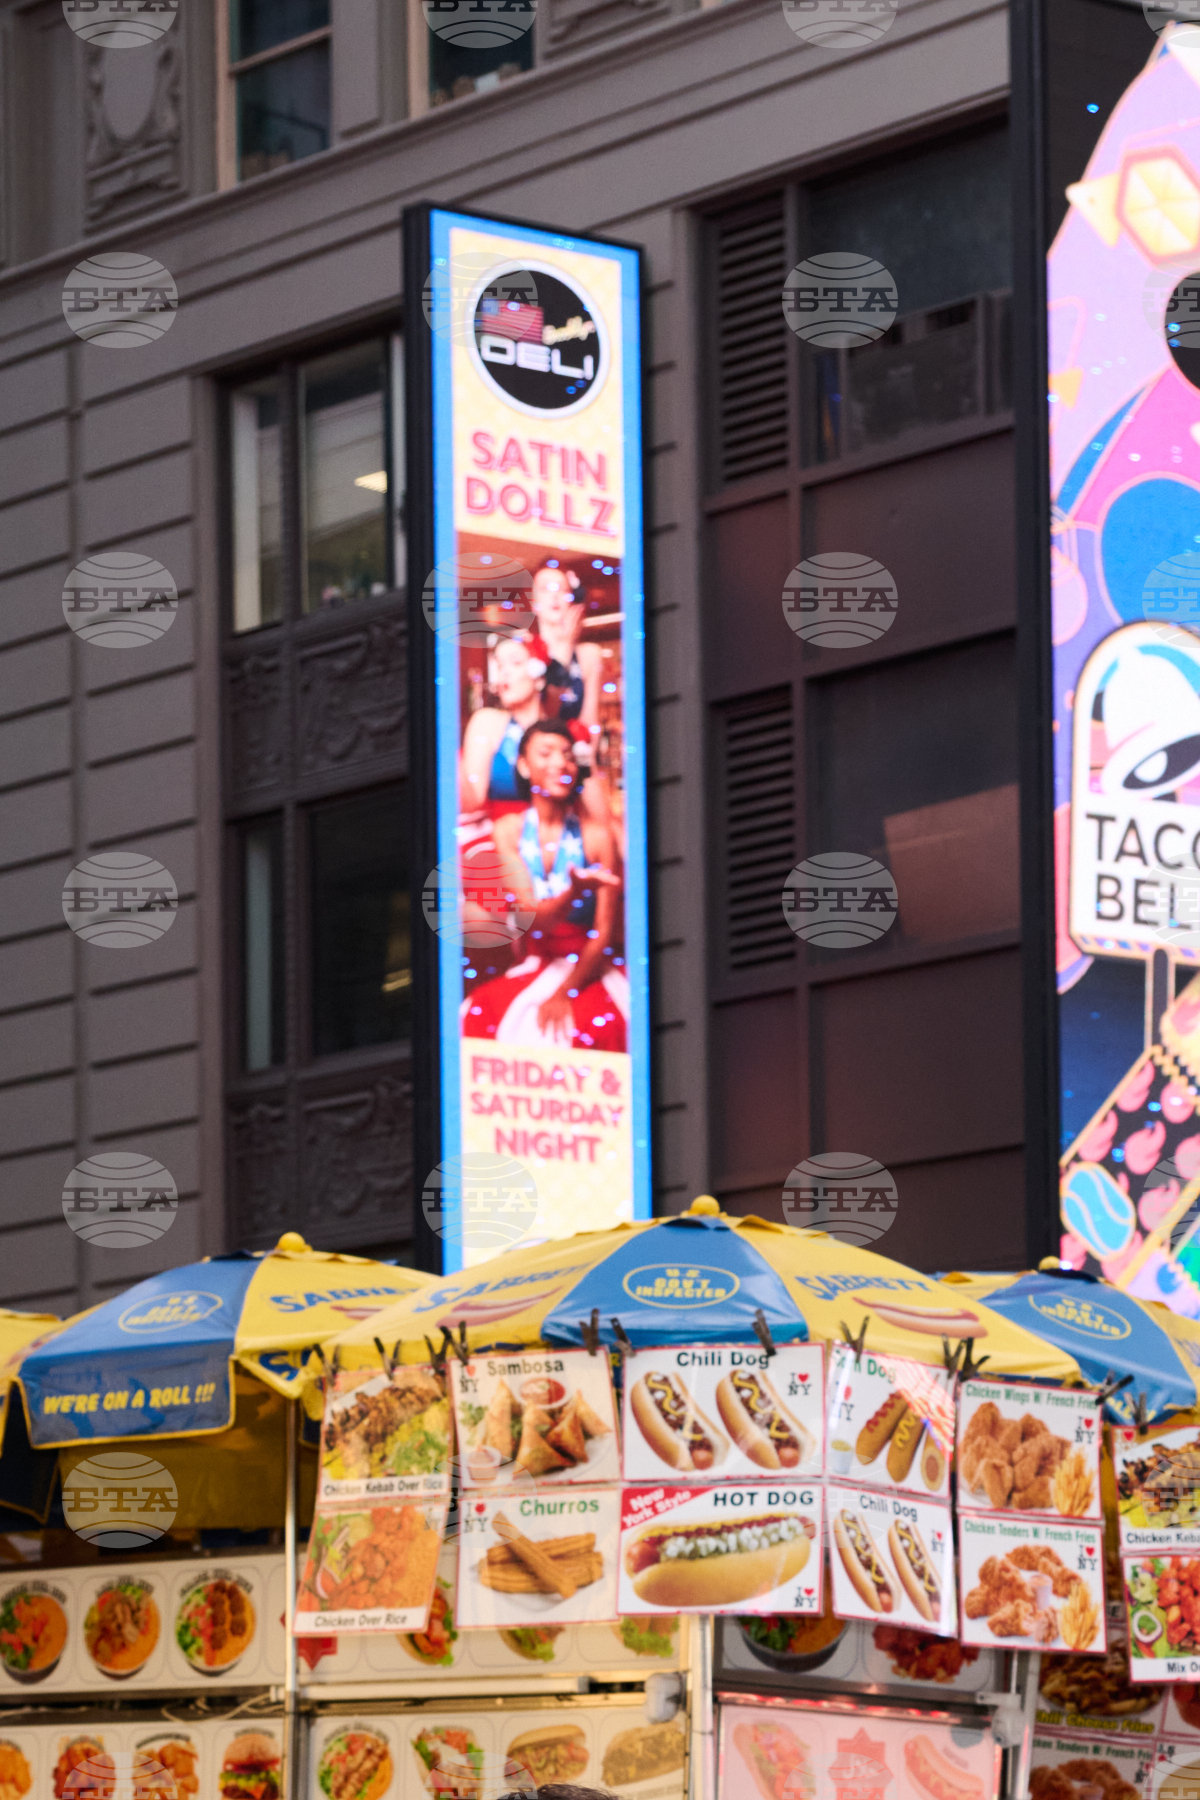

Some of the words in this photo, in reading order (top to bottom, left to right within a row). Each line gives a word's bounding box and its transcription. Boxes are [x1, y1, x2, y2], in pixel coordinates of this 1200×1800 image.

[480, 336, 594, 380] DELI
[471, 431, 607, 490] SATIN
[466, 477, 617, 537] DOLLZ
[471, 1055, 592, 1093] FRIDAY
[601, 1069, 621, 1096] &
[471, 1091, 624, 1127] SATURDAY
[494, 1128, 602, 1164] NIGHT
[636, 1286, 726, 1298] INSPECTED
[487, 1358, 564, 1376] Sambosa
[676, 1351, 722, 1367] Chili
[731, 1351, 770, 1369] Dog
[867, 1359, 896, 1384] Dog
[460, 1378, 478, 1393] NY
[788, 1384, 811, 1396] NY
[44, 1393, 100, 1414] WE'RE
[103, 1391, 129, 1411] ON
[131, 1389, 145, 1408] A
[149, 1385, 191, 1408] ROLL
[966, 1384, 1001, 1399] Chicken
[1004, 1388, 1030, 1405] Wings
[1046, 1393, 1075, 1407] French
[1077, 1395, 1098, 1409] Fries
[1075, 1430, 1095, 1444] NY
[324, 1484, 361, 1496] Chicken
[366, 1480, 394, 1493] Kebab
[398, 1479, 420, 1491] Over
[520, 1499, 599, 1516] Churros
[629, 1488, 665, 1512] New
[714, 1492, 758, 1507] HOT
[768, 1491, 814, 1506] DOG
[860, 1494, 888, 1512] Chili
[893, 1501, 918, 1522] Dog
[623, 1509, 654, 1527] York
[656, 1490, 692, 1514] Style
[464, 1517, 488, 1532] NY
[964, 1520, 996, 1535] Chicken
[998, 1523, 1029, 1538] Tenders
[1045, 1528, 1072, 1541] French
[1076, 1530, 1096, 1543] Fries
[1127, 1532, 1172, 1544] Chicken
[1077, 1557, 1098, 1571] NY
[795, 1597, 816, 1608] NY
[314, 1615, 355, 1628] Chicken
[358, 1613, 382, 1626] Over
[385, 1612, 408, 1625] Rice
[1167, 1661, 1186, 1674] Mix
[1036, 1709, 1062, 1725] hili
[1066, 1713, 1117, 1730] Cheese
[1121, 1719, 1154, 1733] Fries
